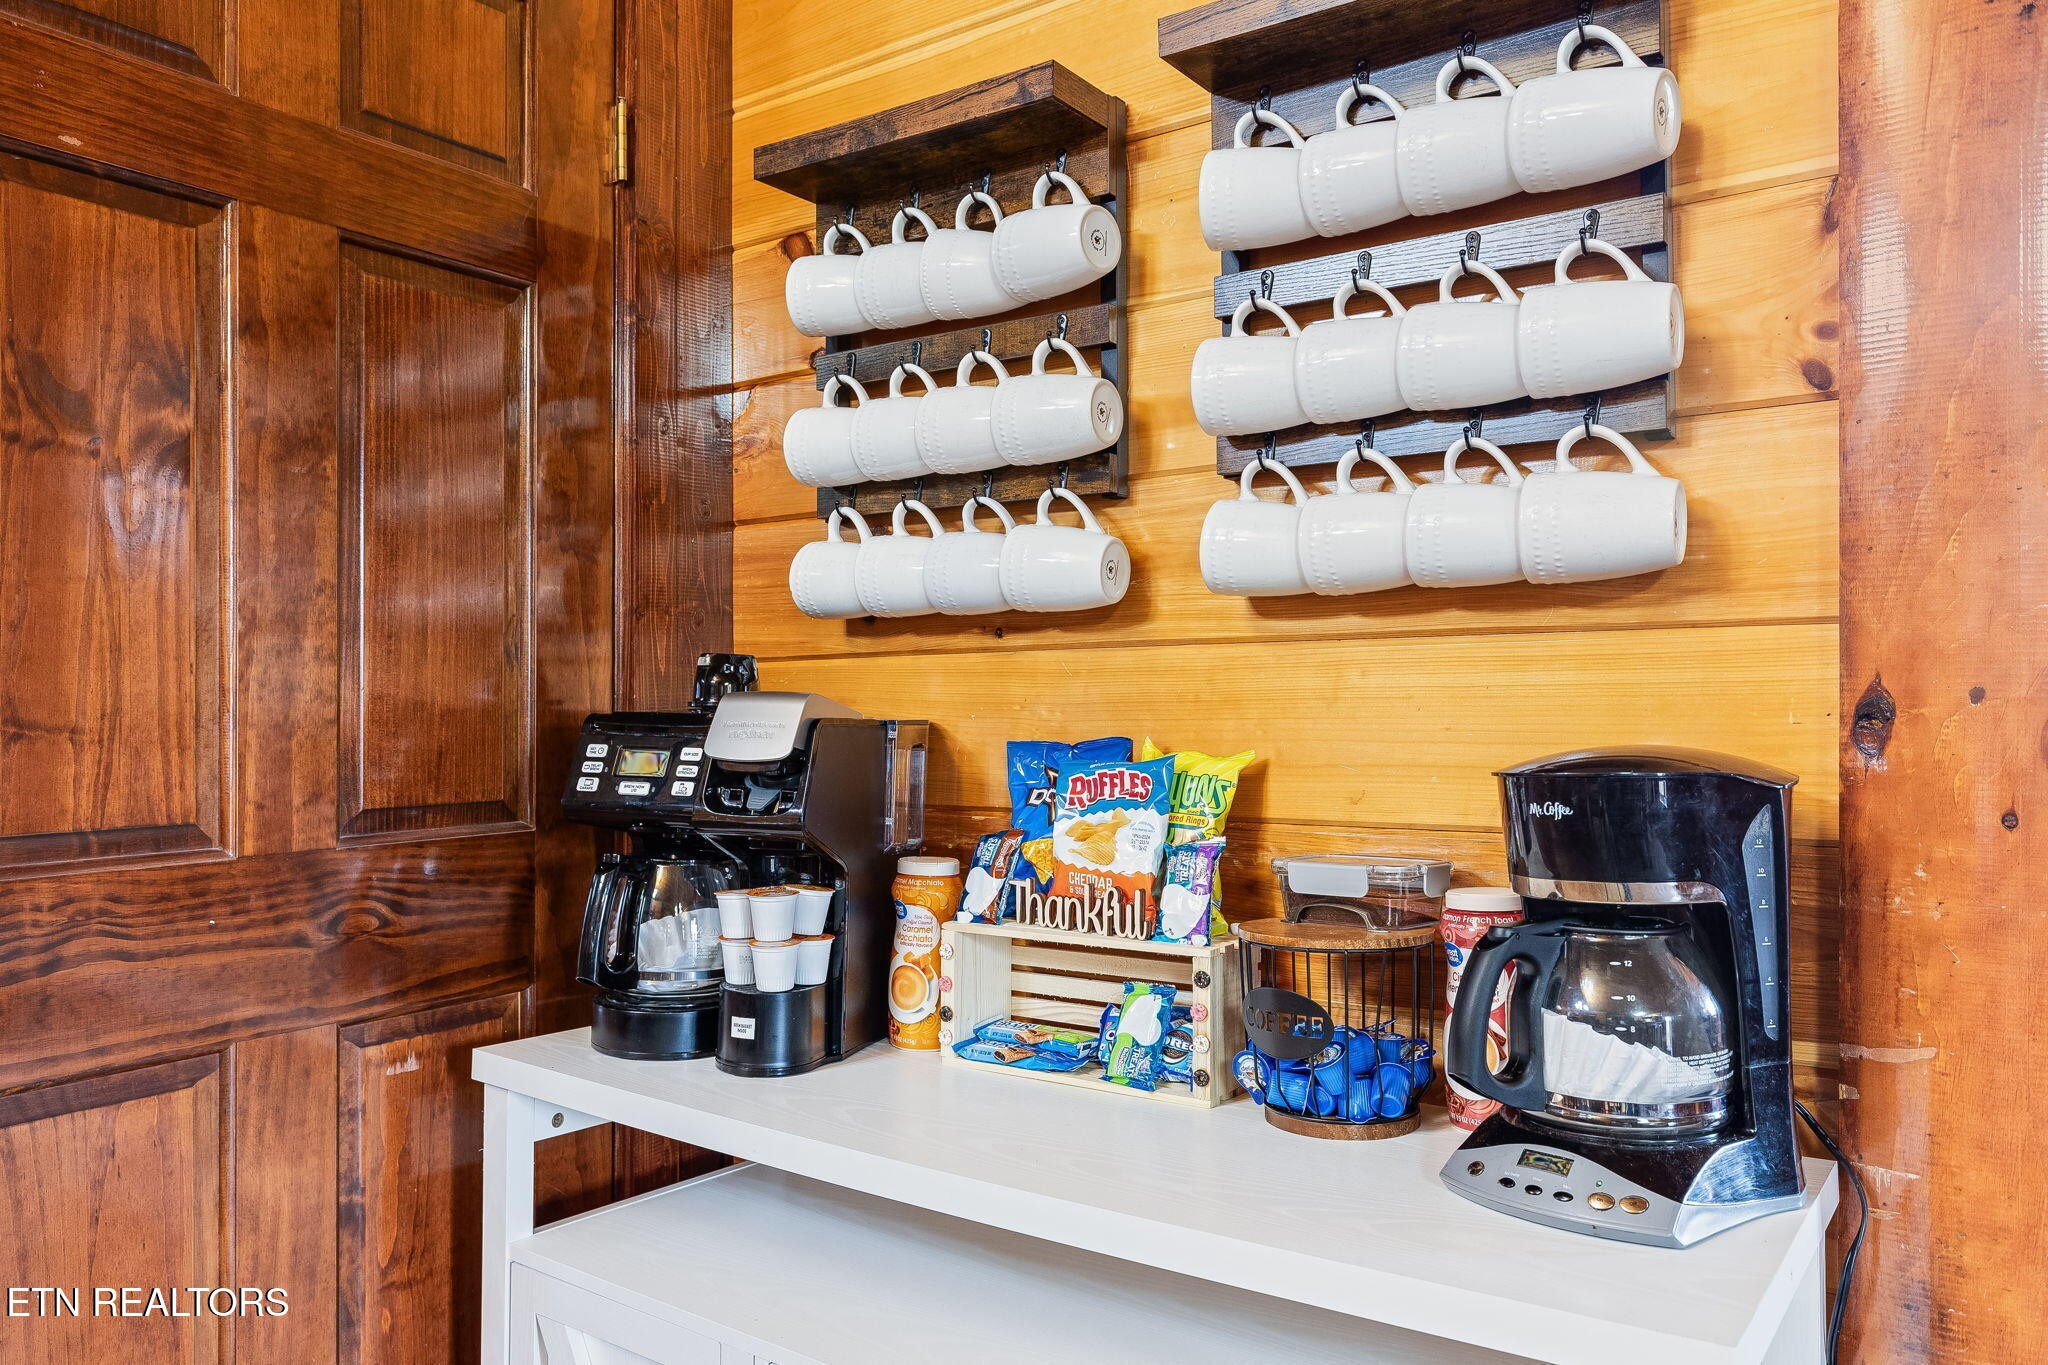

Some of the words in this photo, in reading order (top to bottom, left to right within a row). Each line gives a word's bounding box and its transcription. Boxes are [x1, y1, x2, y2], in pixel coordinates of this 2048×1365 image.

[1066, 769, 1152, 810] RUFFLES
[1169, 771, 1232, 816] YUNS
[1186, 816, 1206, 825] Rings
[1530, 803, 1543, 818] Mr.
[1544, 802, 1573, 820] Coffee
[984, 837, 999, 867] TREATS
[1180, 850, 1192, 882] TREATS
[1069, 871, 1112, 889] CHEDDAR
[1008, 877, 1149, 941] Thankful
[1462, 915, 1491, 924] French
[1494, 916, 1514, 925] Toast
[901, 923, 934, 934] Caramel
[1247, 1006, 1324, 1039] COFFEE
[1128, 1046, 1143, 1078] TREATS
